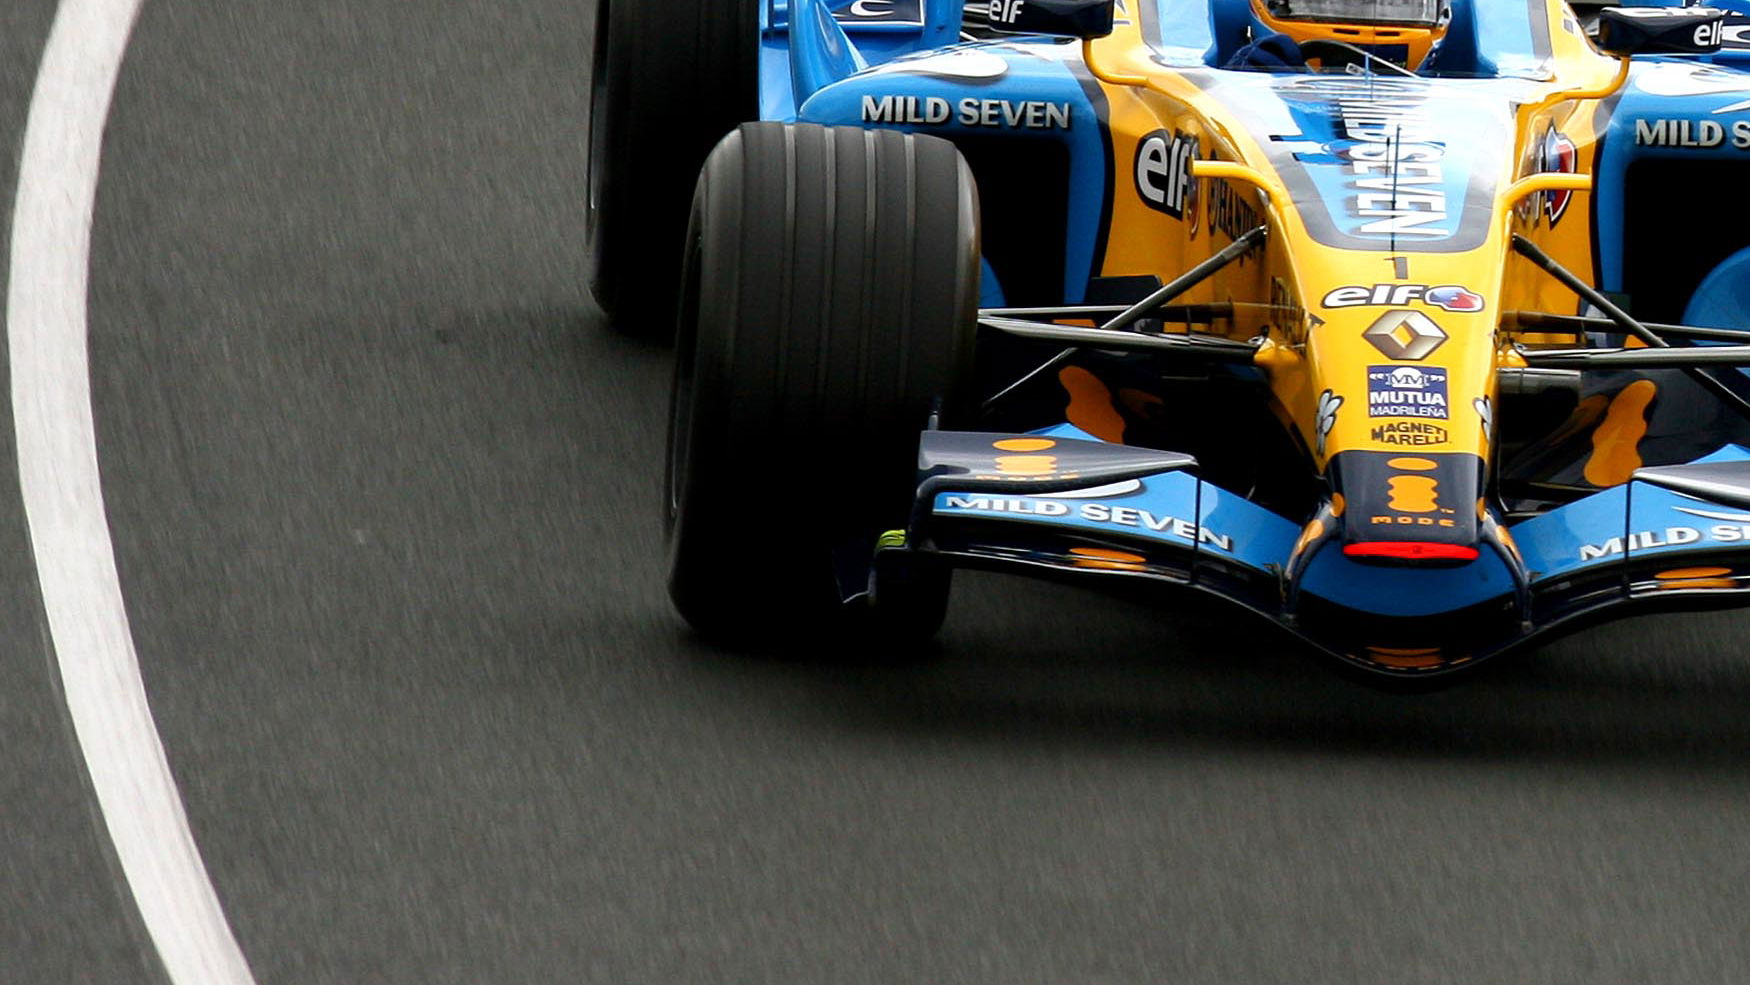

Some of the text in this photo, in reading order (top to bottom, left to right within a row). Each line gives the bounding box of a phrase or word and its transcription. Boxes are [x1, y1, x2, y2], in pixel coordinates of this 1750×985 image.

[1693, 20, 1723, 47] elf
[861, 95, 1069, 128] MILD SEVEN
[1636, 119, 1723, 146] MILD
[1137, 137, 1189, 211] elf
[1349, 143, 1449, 236] SEVEN
[1323, 285, 1425, 307] elf
[1369, 391, 1446, 407] MUTUA
[1370, 406, 1447, 418] MADRILEÑA
[946, 495, 1230, 550] MILD SEVEN
[1580, 527, 1700, 561] MILD
